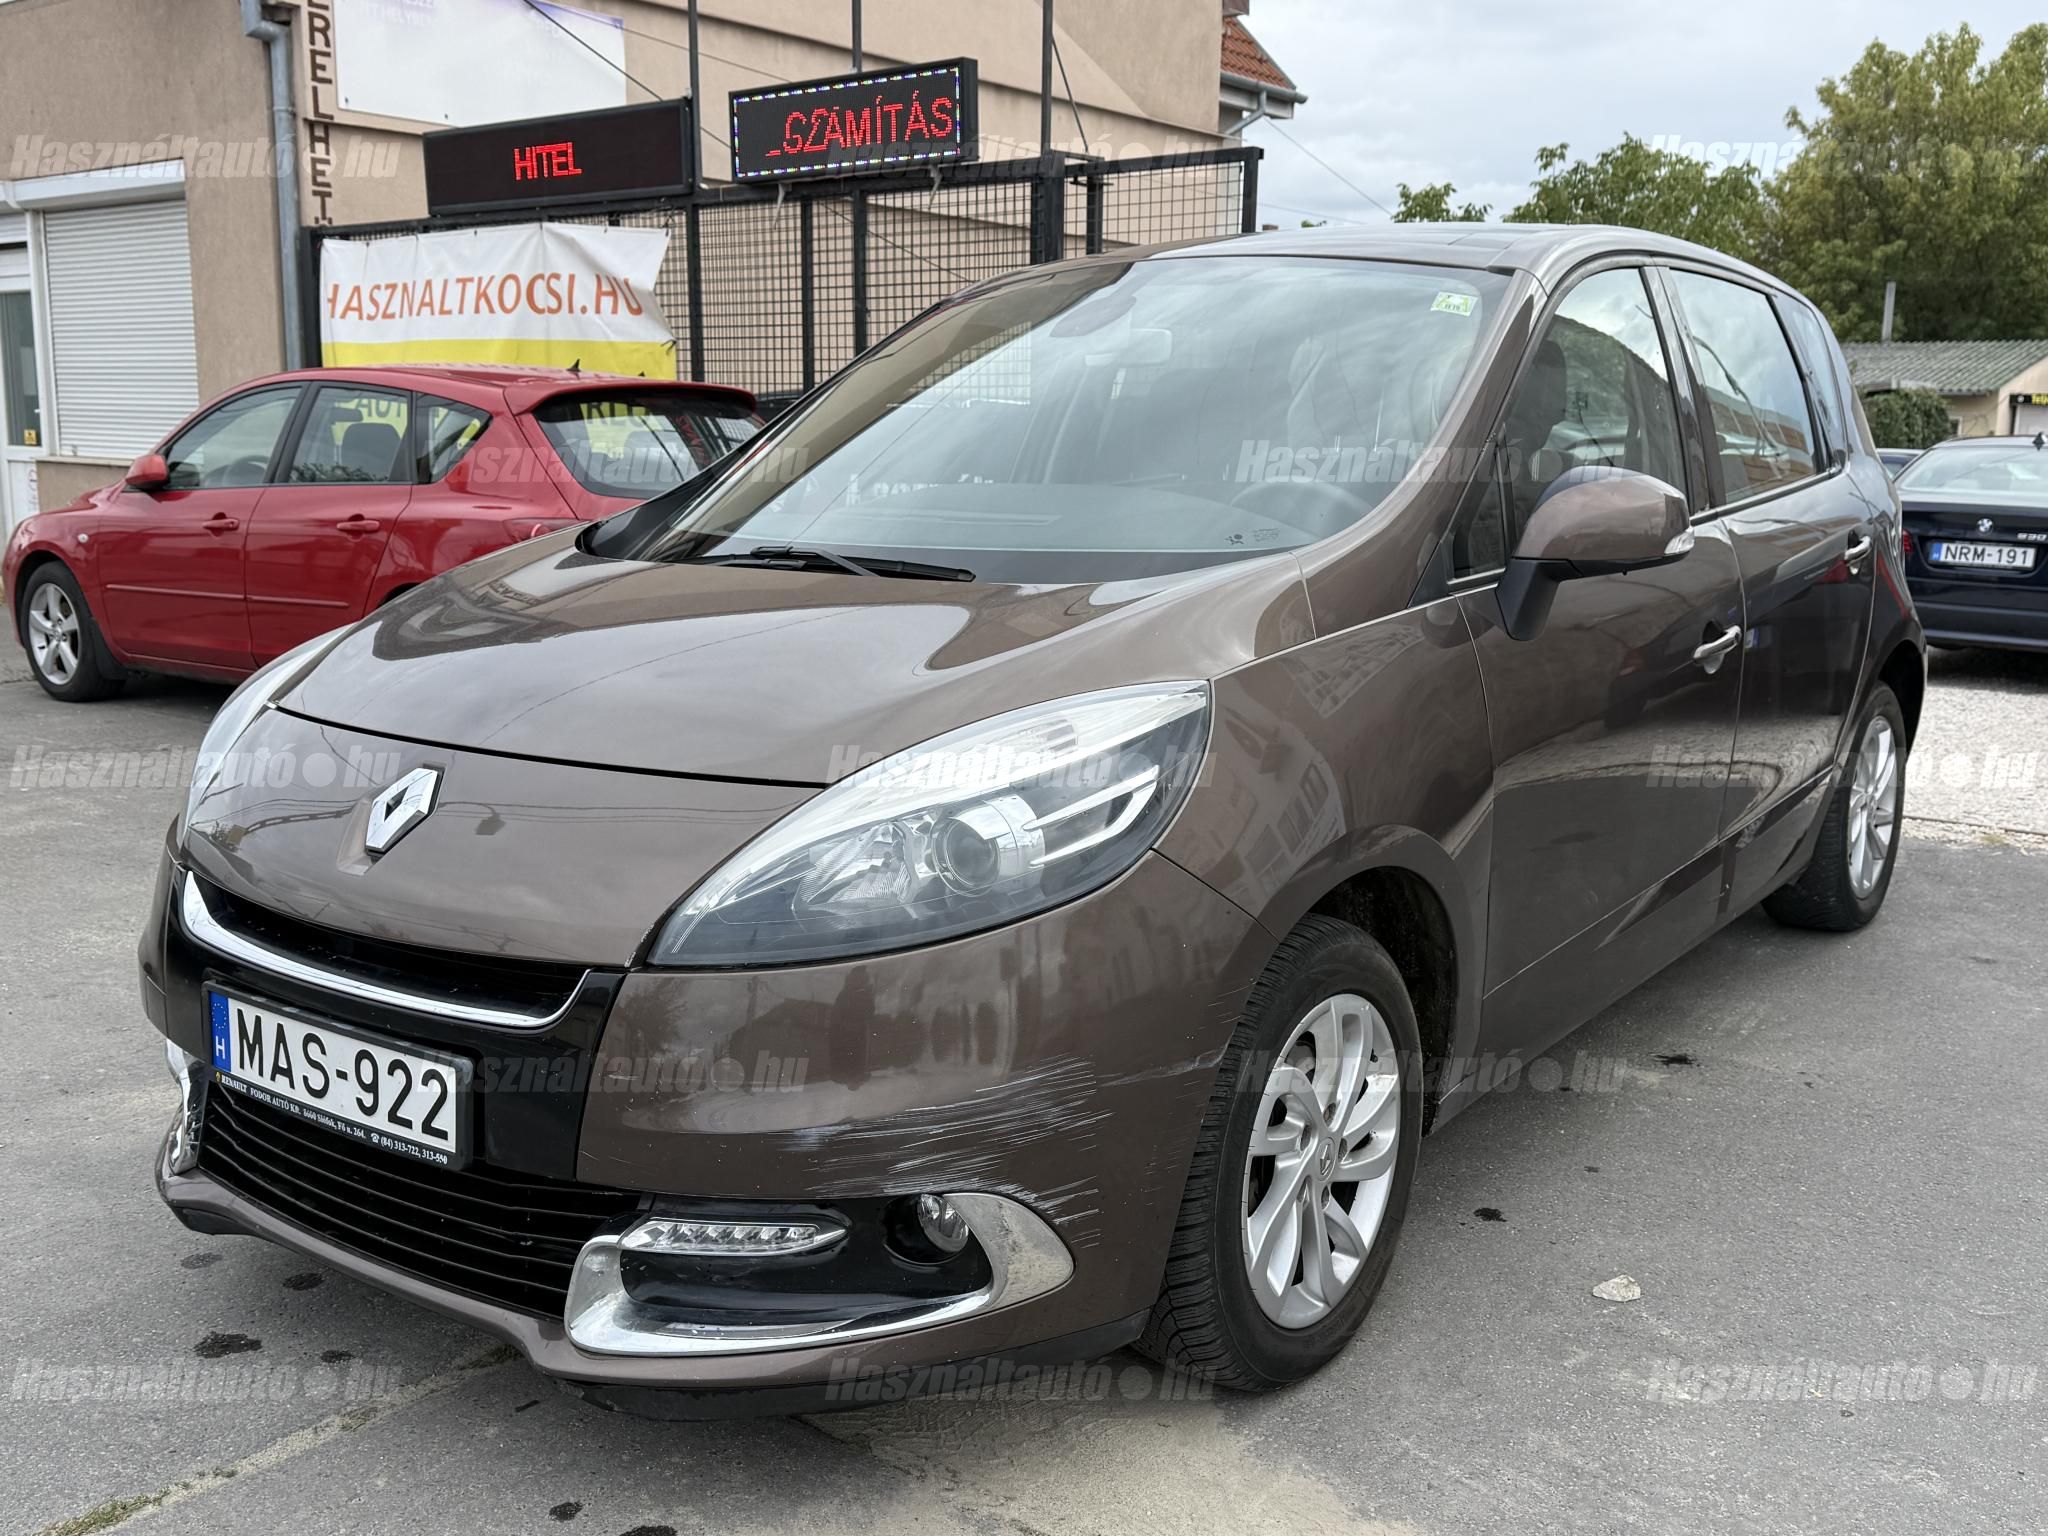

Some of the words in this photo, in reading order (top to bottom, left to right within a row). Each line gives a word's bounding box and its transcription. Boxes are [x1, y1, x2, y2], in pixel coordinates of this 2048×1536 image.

[307, 0, 333, 225] RELHET
[513, 141, 583, 181] HITEL
[1945, 545, 2027, 565] NRM-191
[214, 1035, 227, 1060] H
[237, 1008, 449, 1141] MAS-922
[221, 1074, 248, 1094] RENAULT
[250, 1087, 272, 1103] FODOR
[272, 1098, 289, 1111] AUTÓ
[380, 1136, 394, 1150] (84)
[394, 1140, 421, 1158] 313-722,
